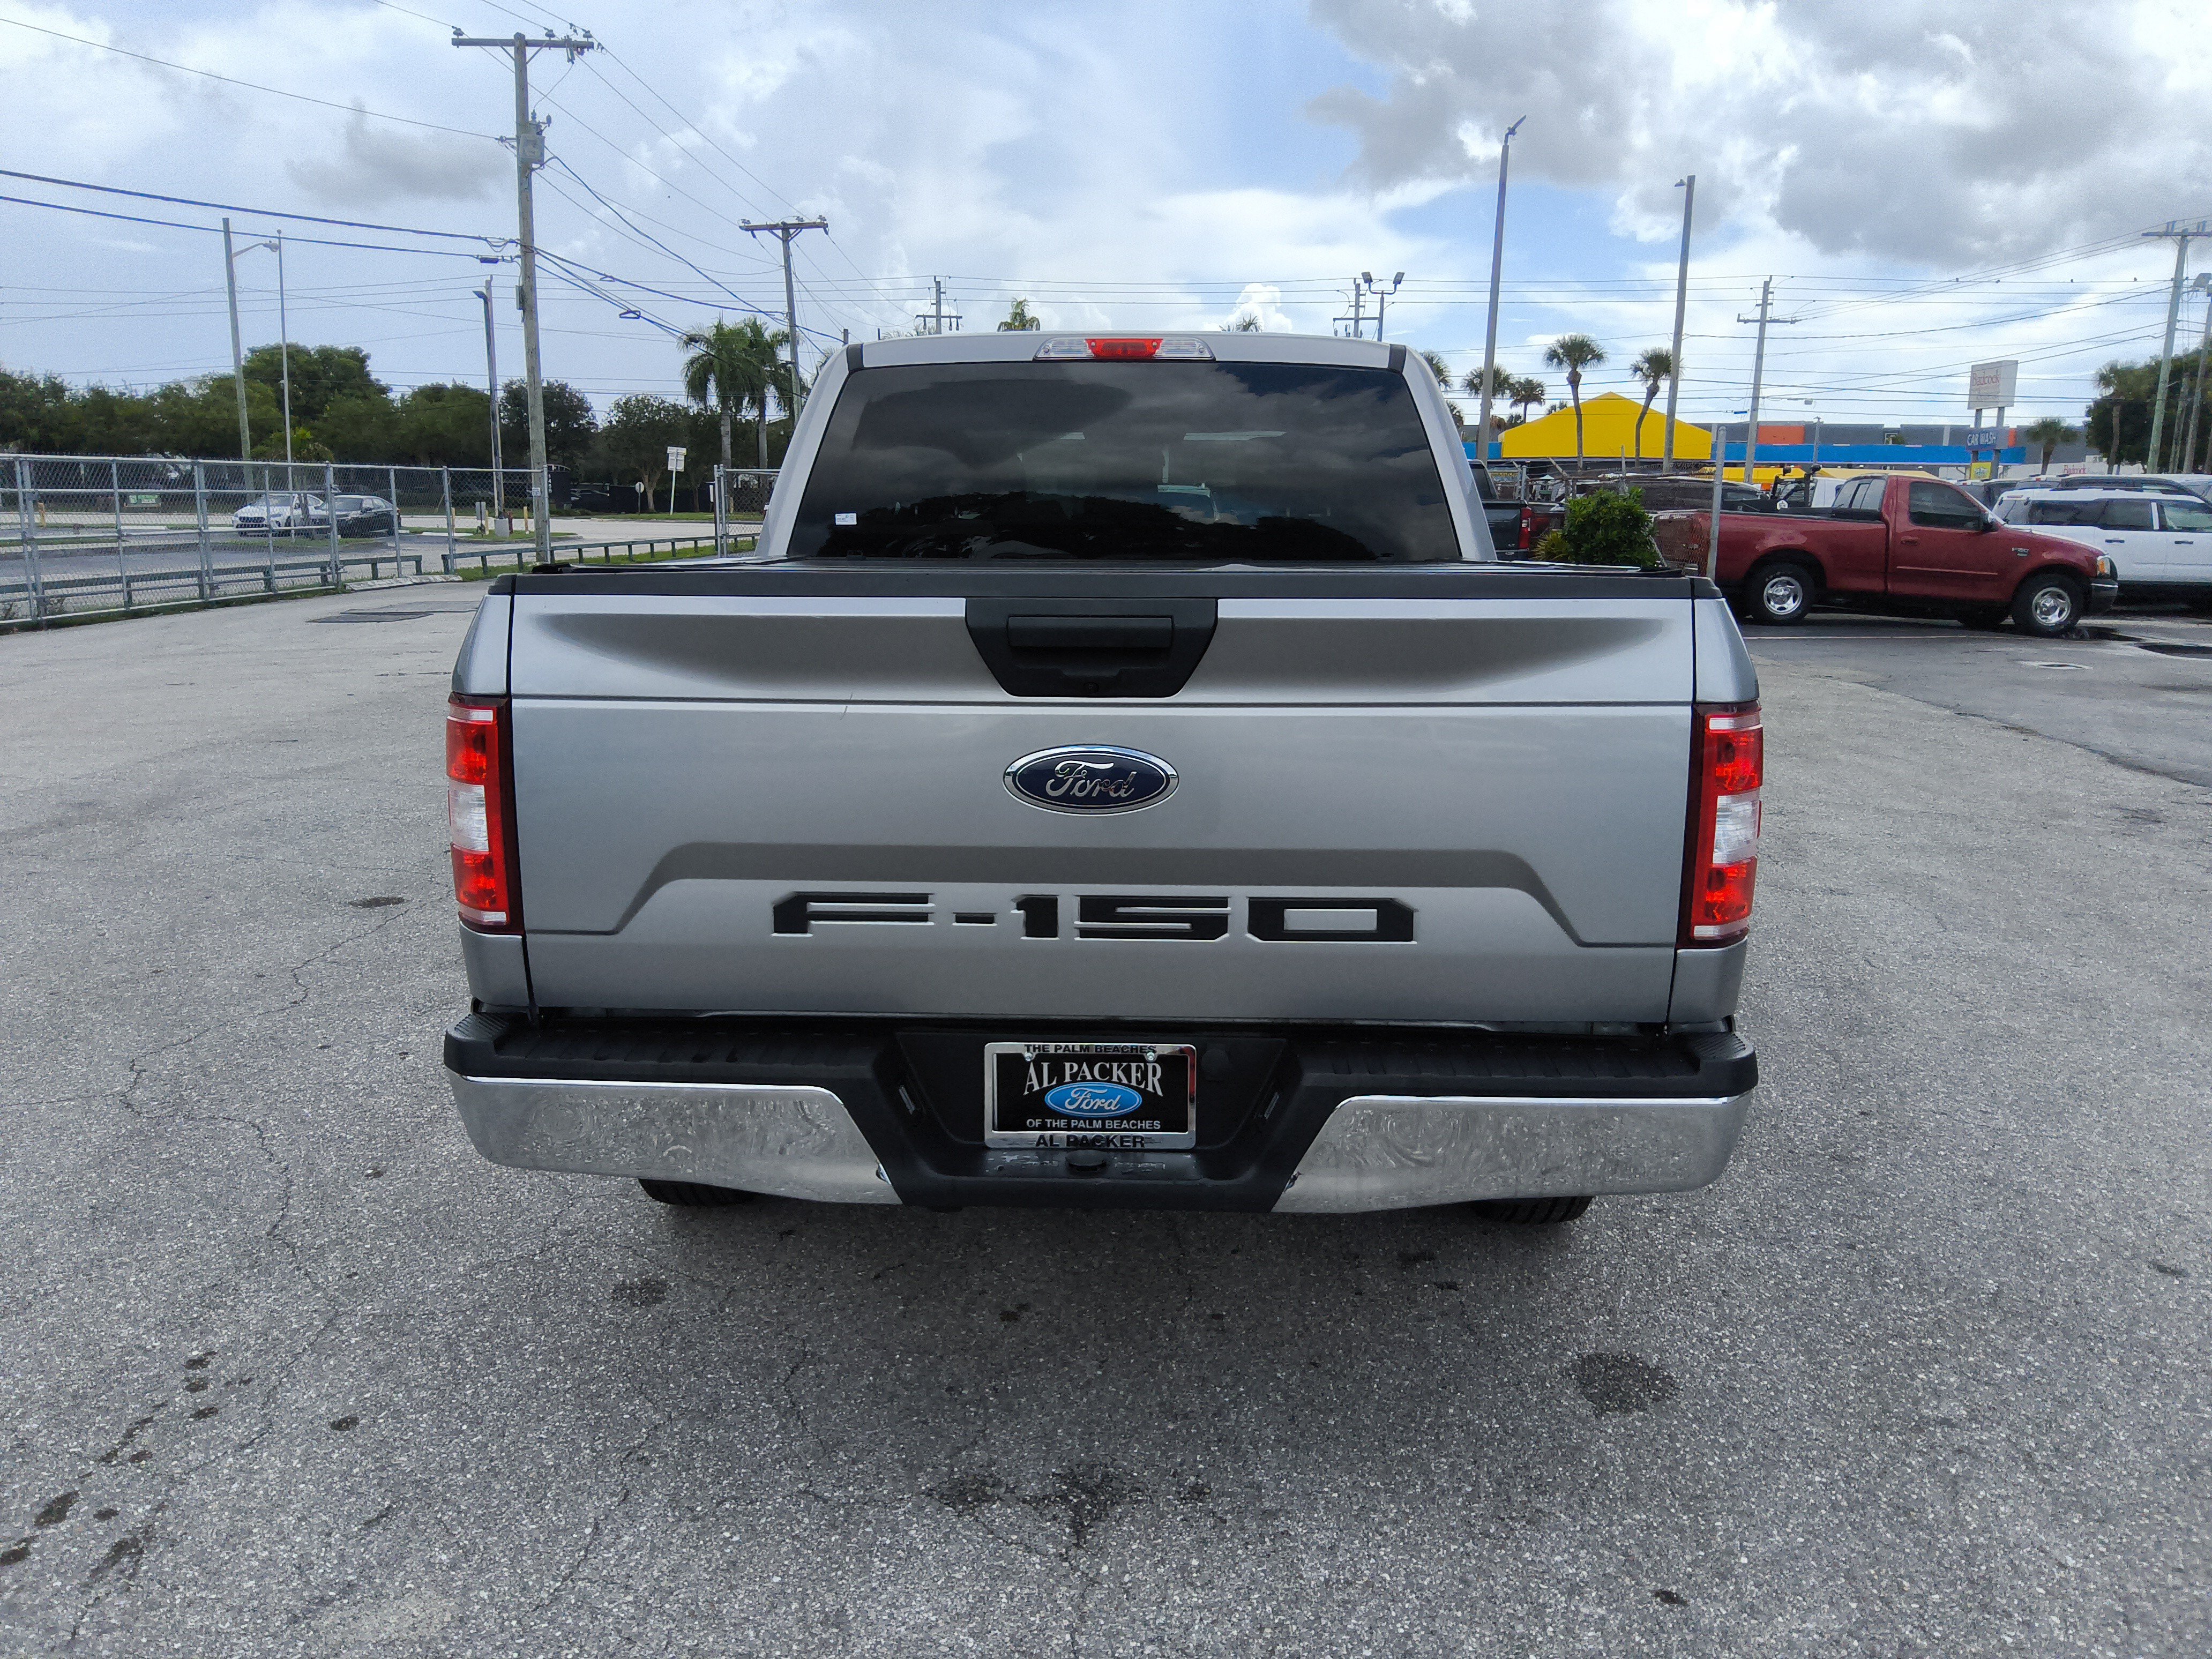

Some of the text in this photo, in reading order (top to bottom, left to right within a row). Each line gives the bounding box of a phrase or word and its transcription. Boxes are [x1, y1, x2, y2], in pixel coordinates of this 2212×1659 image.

[1967, 434, 1979, 446] CAR
[1045, 760, 1137, 797] Ford
[772, 892, 1416, 944] F-150
[1023, 1044, 1157, 1054] THE PALM BEACHES
[1023, 1062, 1163, 1097] AL PACKER
[1065, 1087, 1120, 1111] Ford
[1026, 1118, 1161, 1130] OF THE PALM BEACHES
[1035, 1133, 1146, 1148] AL PACKER
